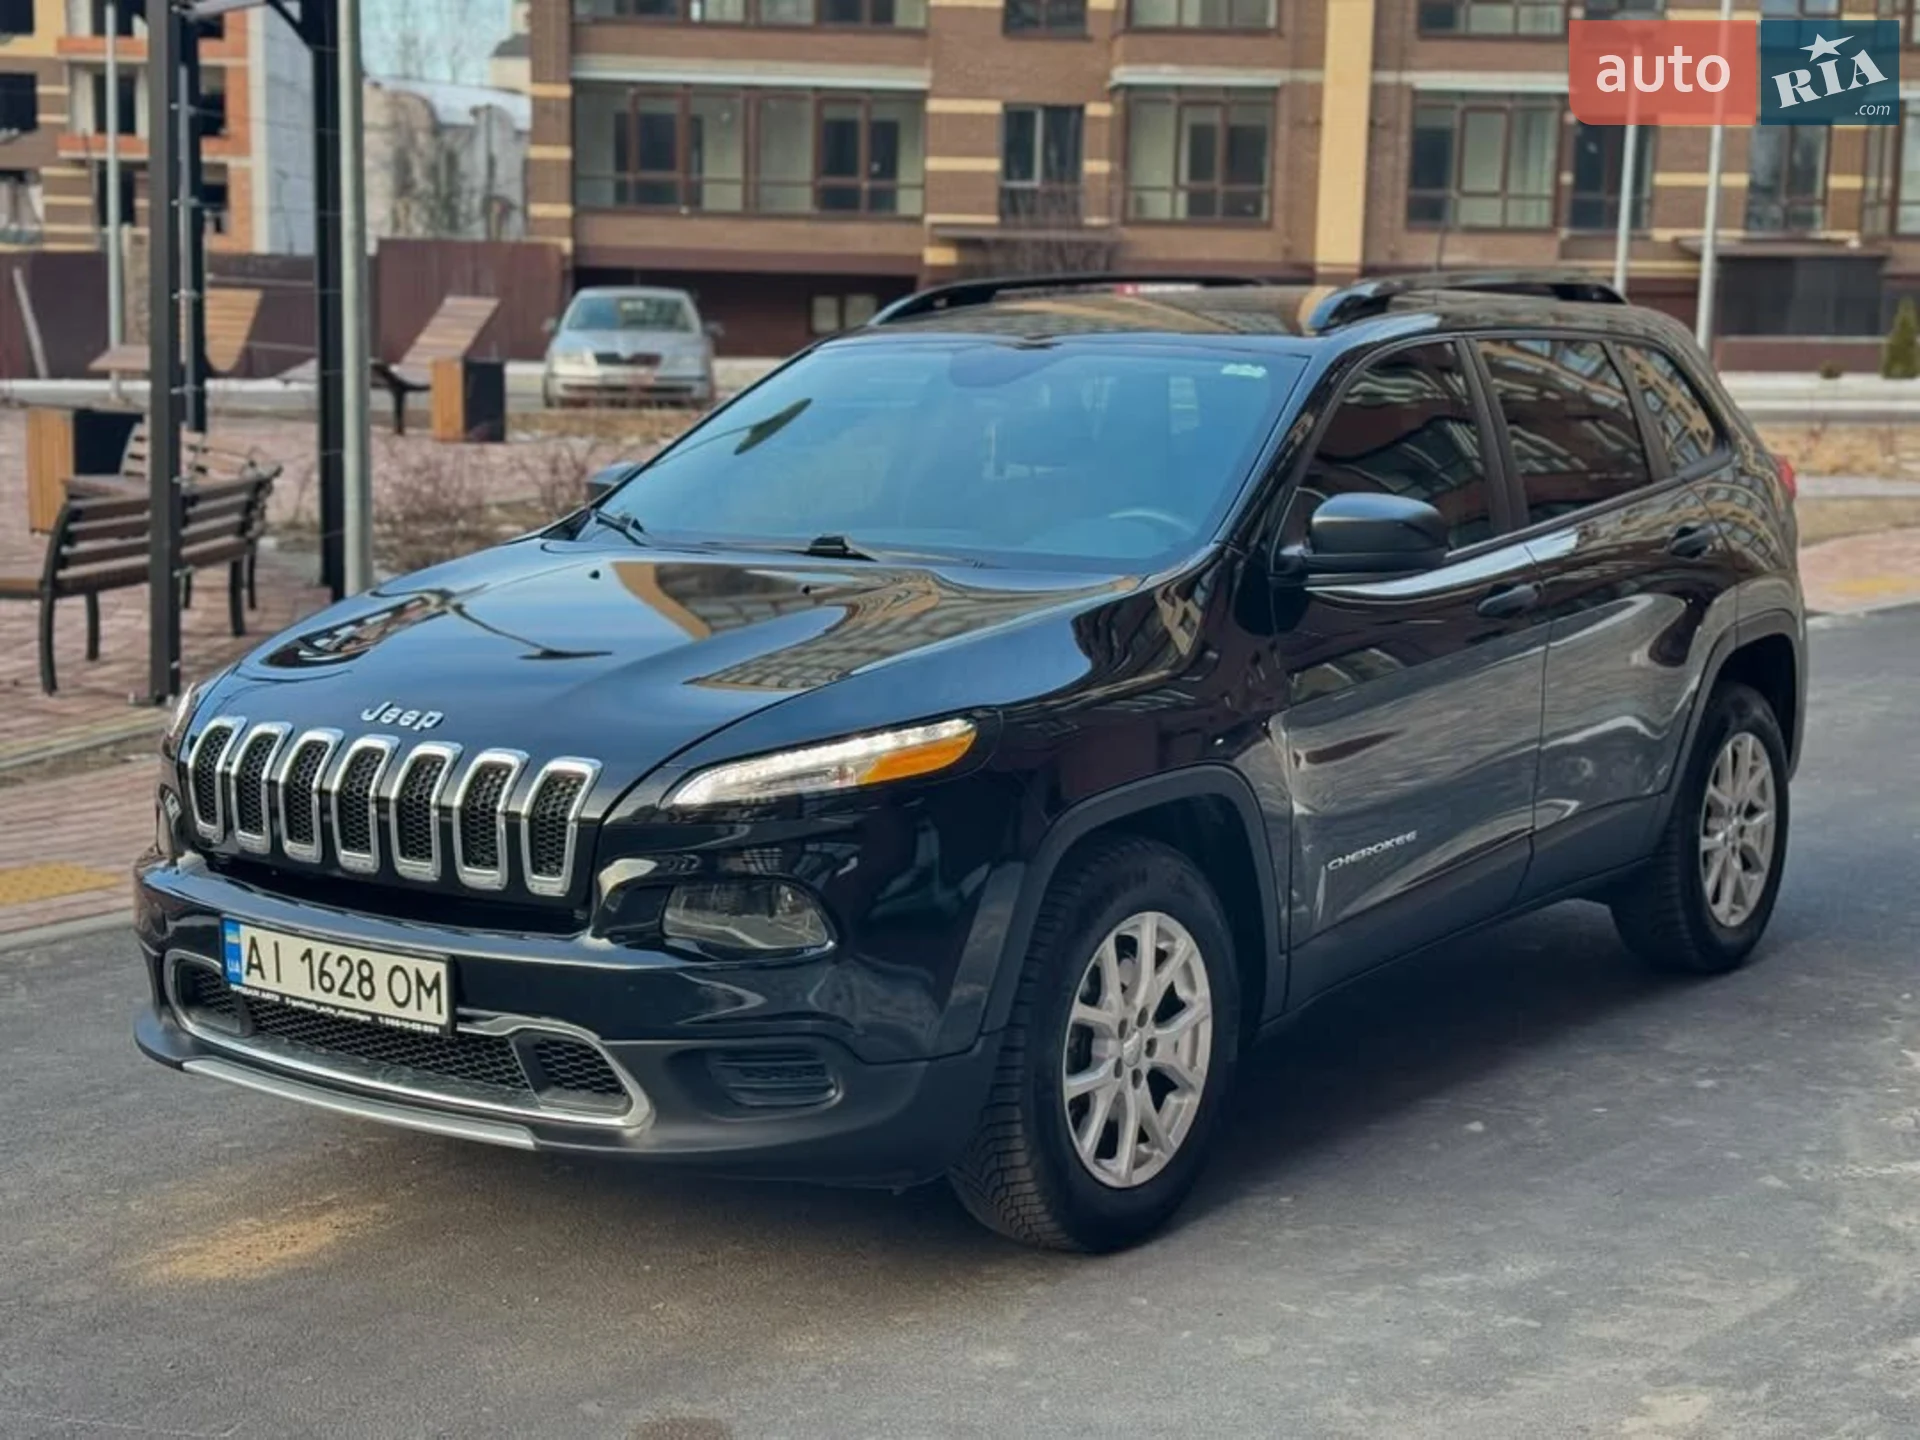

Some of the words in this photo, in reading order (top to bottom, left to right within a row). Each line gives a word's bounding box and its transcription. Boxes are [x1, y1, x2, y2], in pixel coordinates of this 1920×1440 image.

[360, 701, 444, 732] Jeep
[1327, 829, 1418, 871] CHEROKEE
[246, 936, 282, 984] AI
[300, 948, 376, 1002] 1628
[387, 964, 442, 1015] OM
